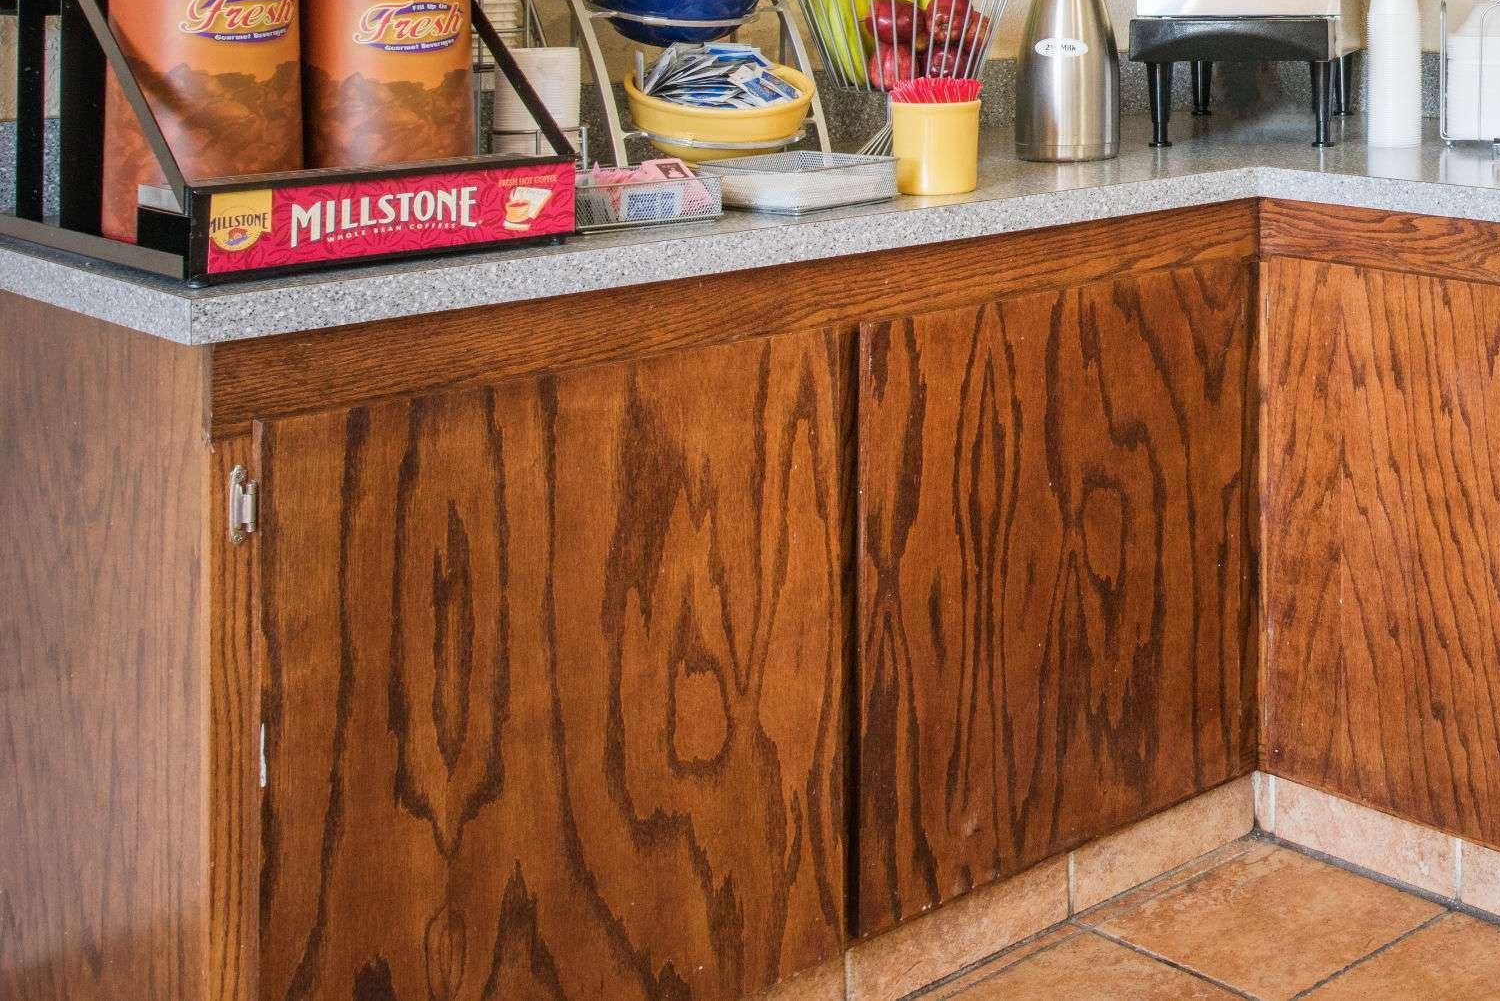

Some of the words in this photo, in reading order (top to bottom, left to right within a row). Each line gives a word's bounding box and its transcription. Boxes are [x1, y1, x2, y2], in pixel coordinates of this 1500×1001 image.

[352, 0, 462, 44] Fresh
[214, 33, 252, 41] Gourmet
[518, 176, 533, 186] HOT
[209, 212, 269, 233] MILLSTONE
[290, 186, 478, 248] MILLSTONE
[326, 229, 366, 243] WHOLE
[373, 225, 403, 234] BEAN
[409, 223, 456, 231] COFFEES
